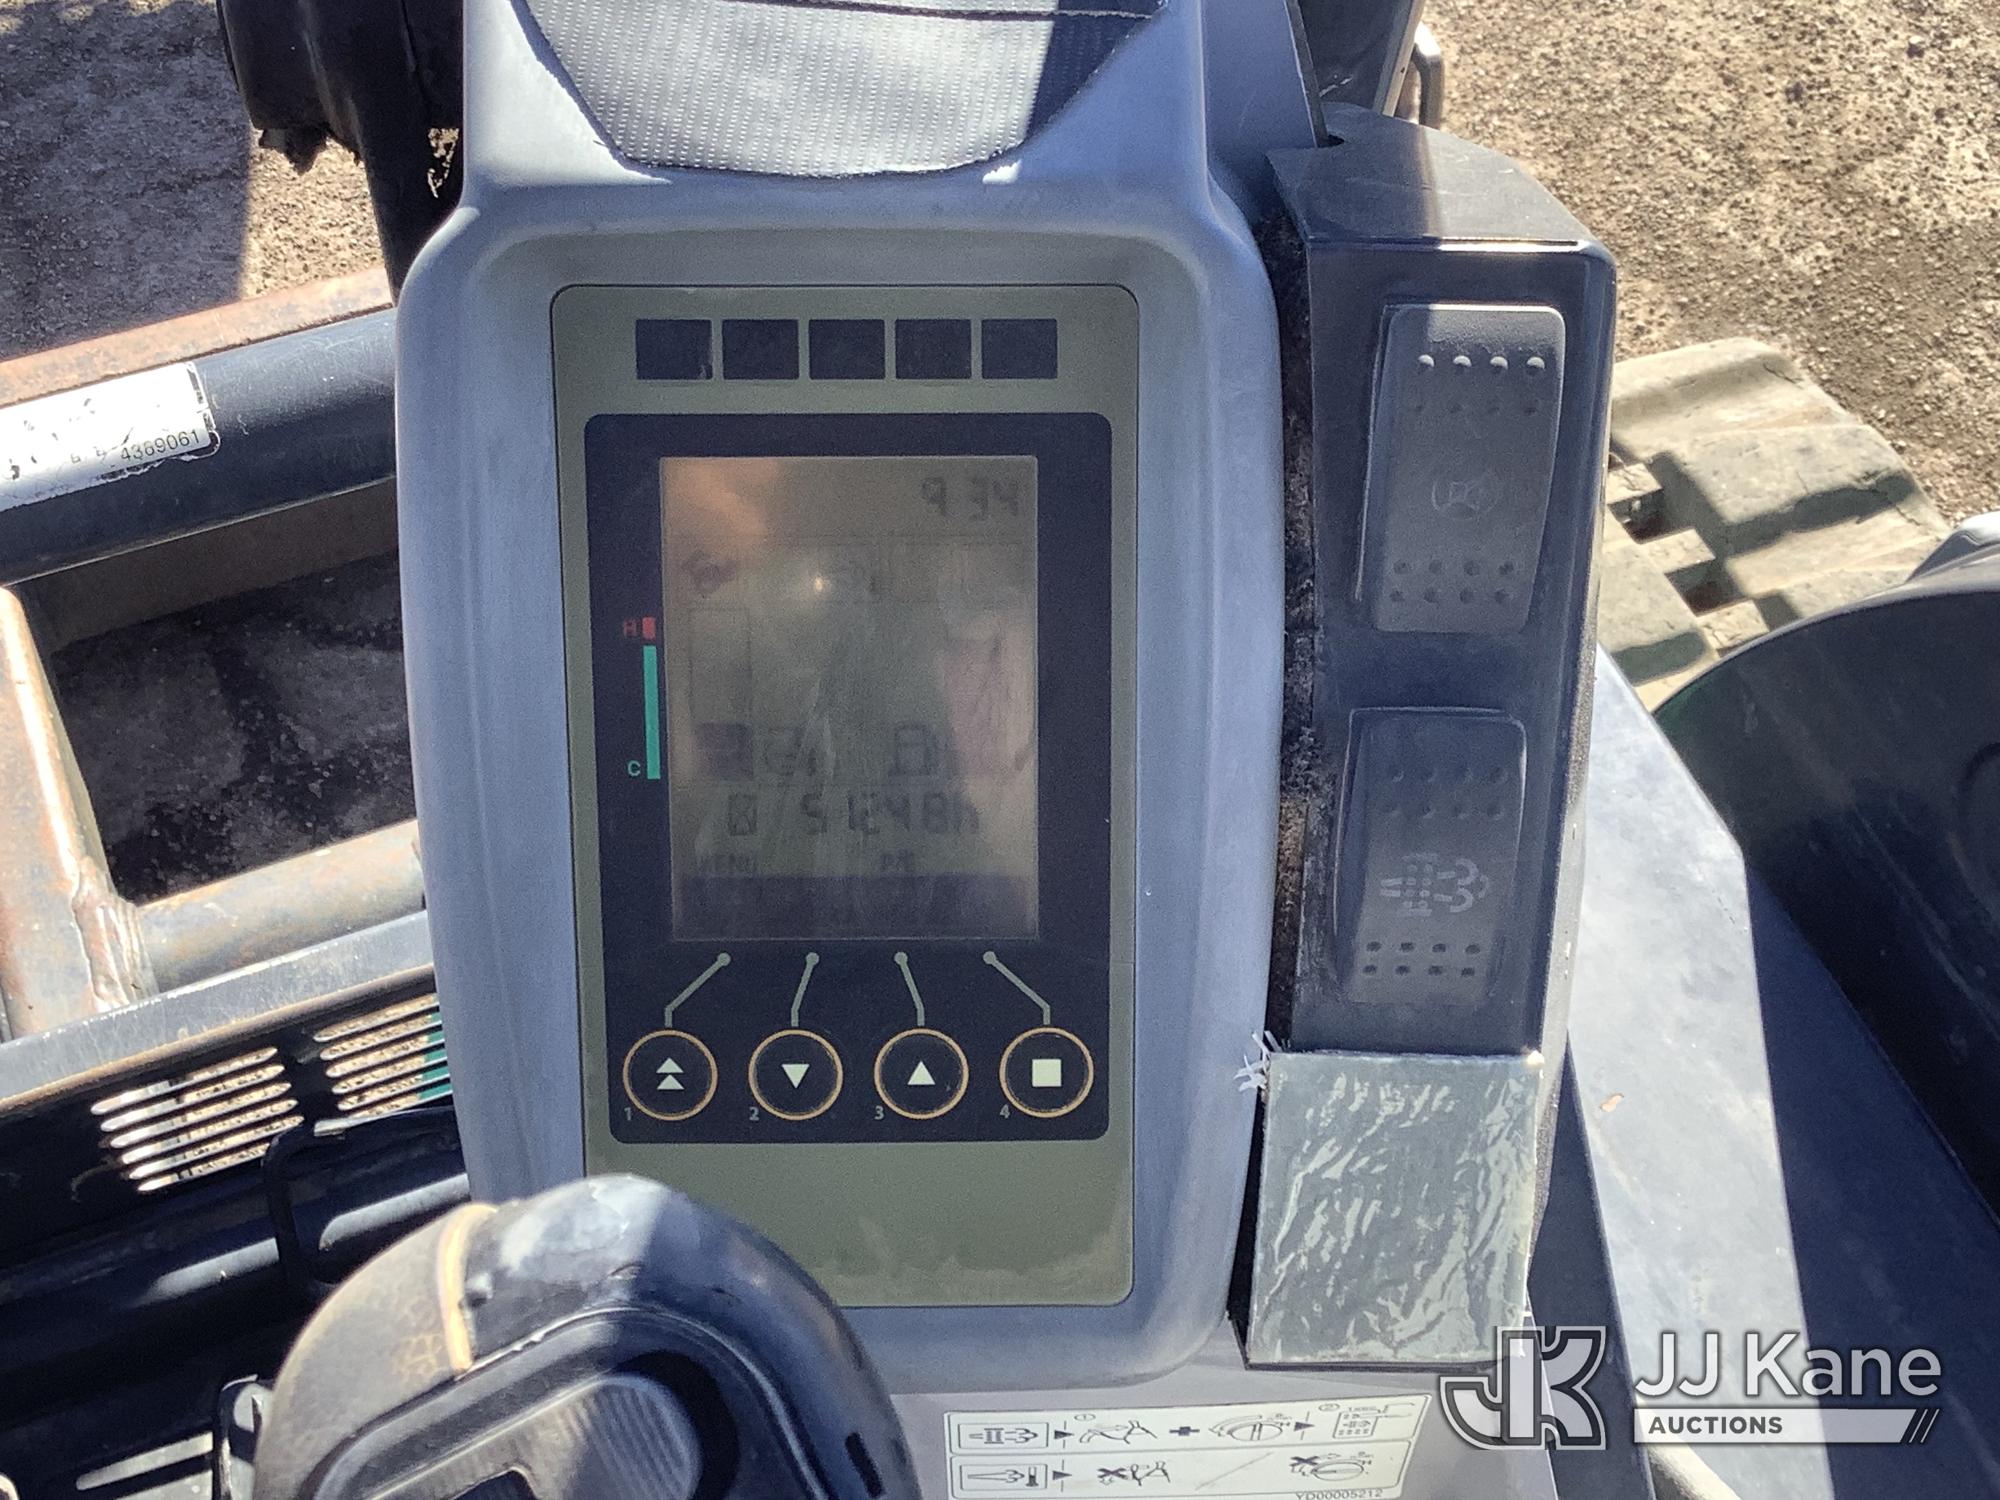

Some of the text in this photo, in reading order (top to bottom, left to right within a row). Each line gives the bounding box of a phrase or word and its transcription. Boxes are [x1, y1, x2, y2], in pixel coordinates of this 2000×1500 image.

[623, 619, 637, 636] H
[627, 760, 641, 777] C
[624, 1106, 632, 1121] 1
[749, 1106, 760, 1121] 2
[874, 1106, 885, 1121] 3
[999, 1105, 1011, 1119] 4
